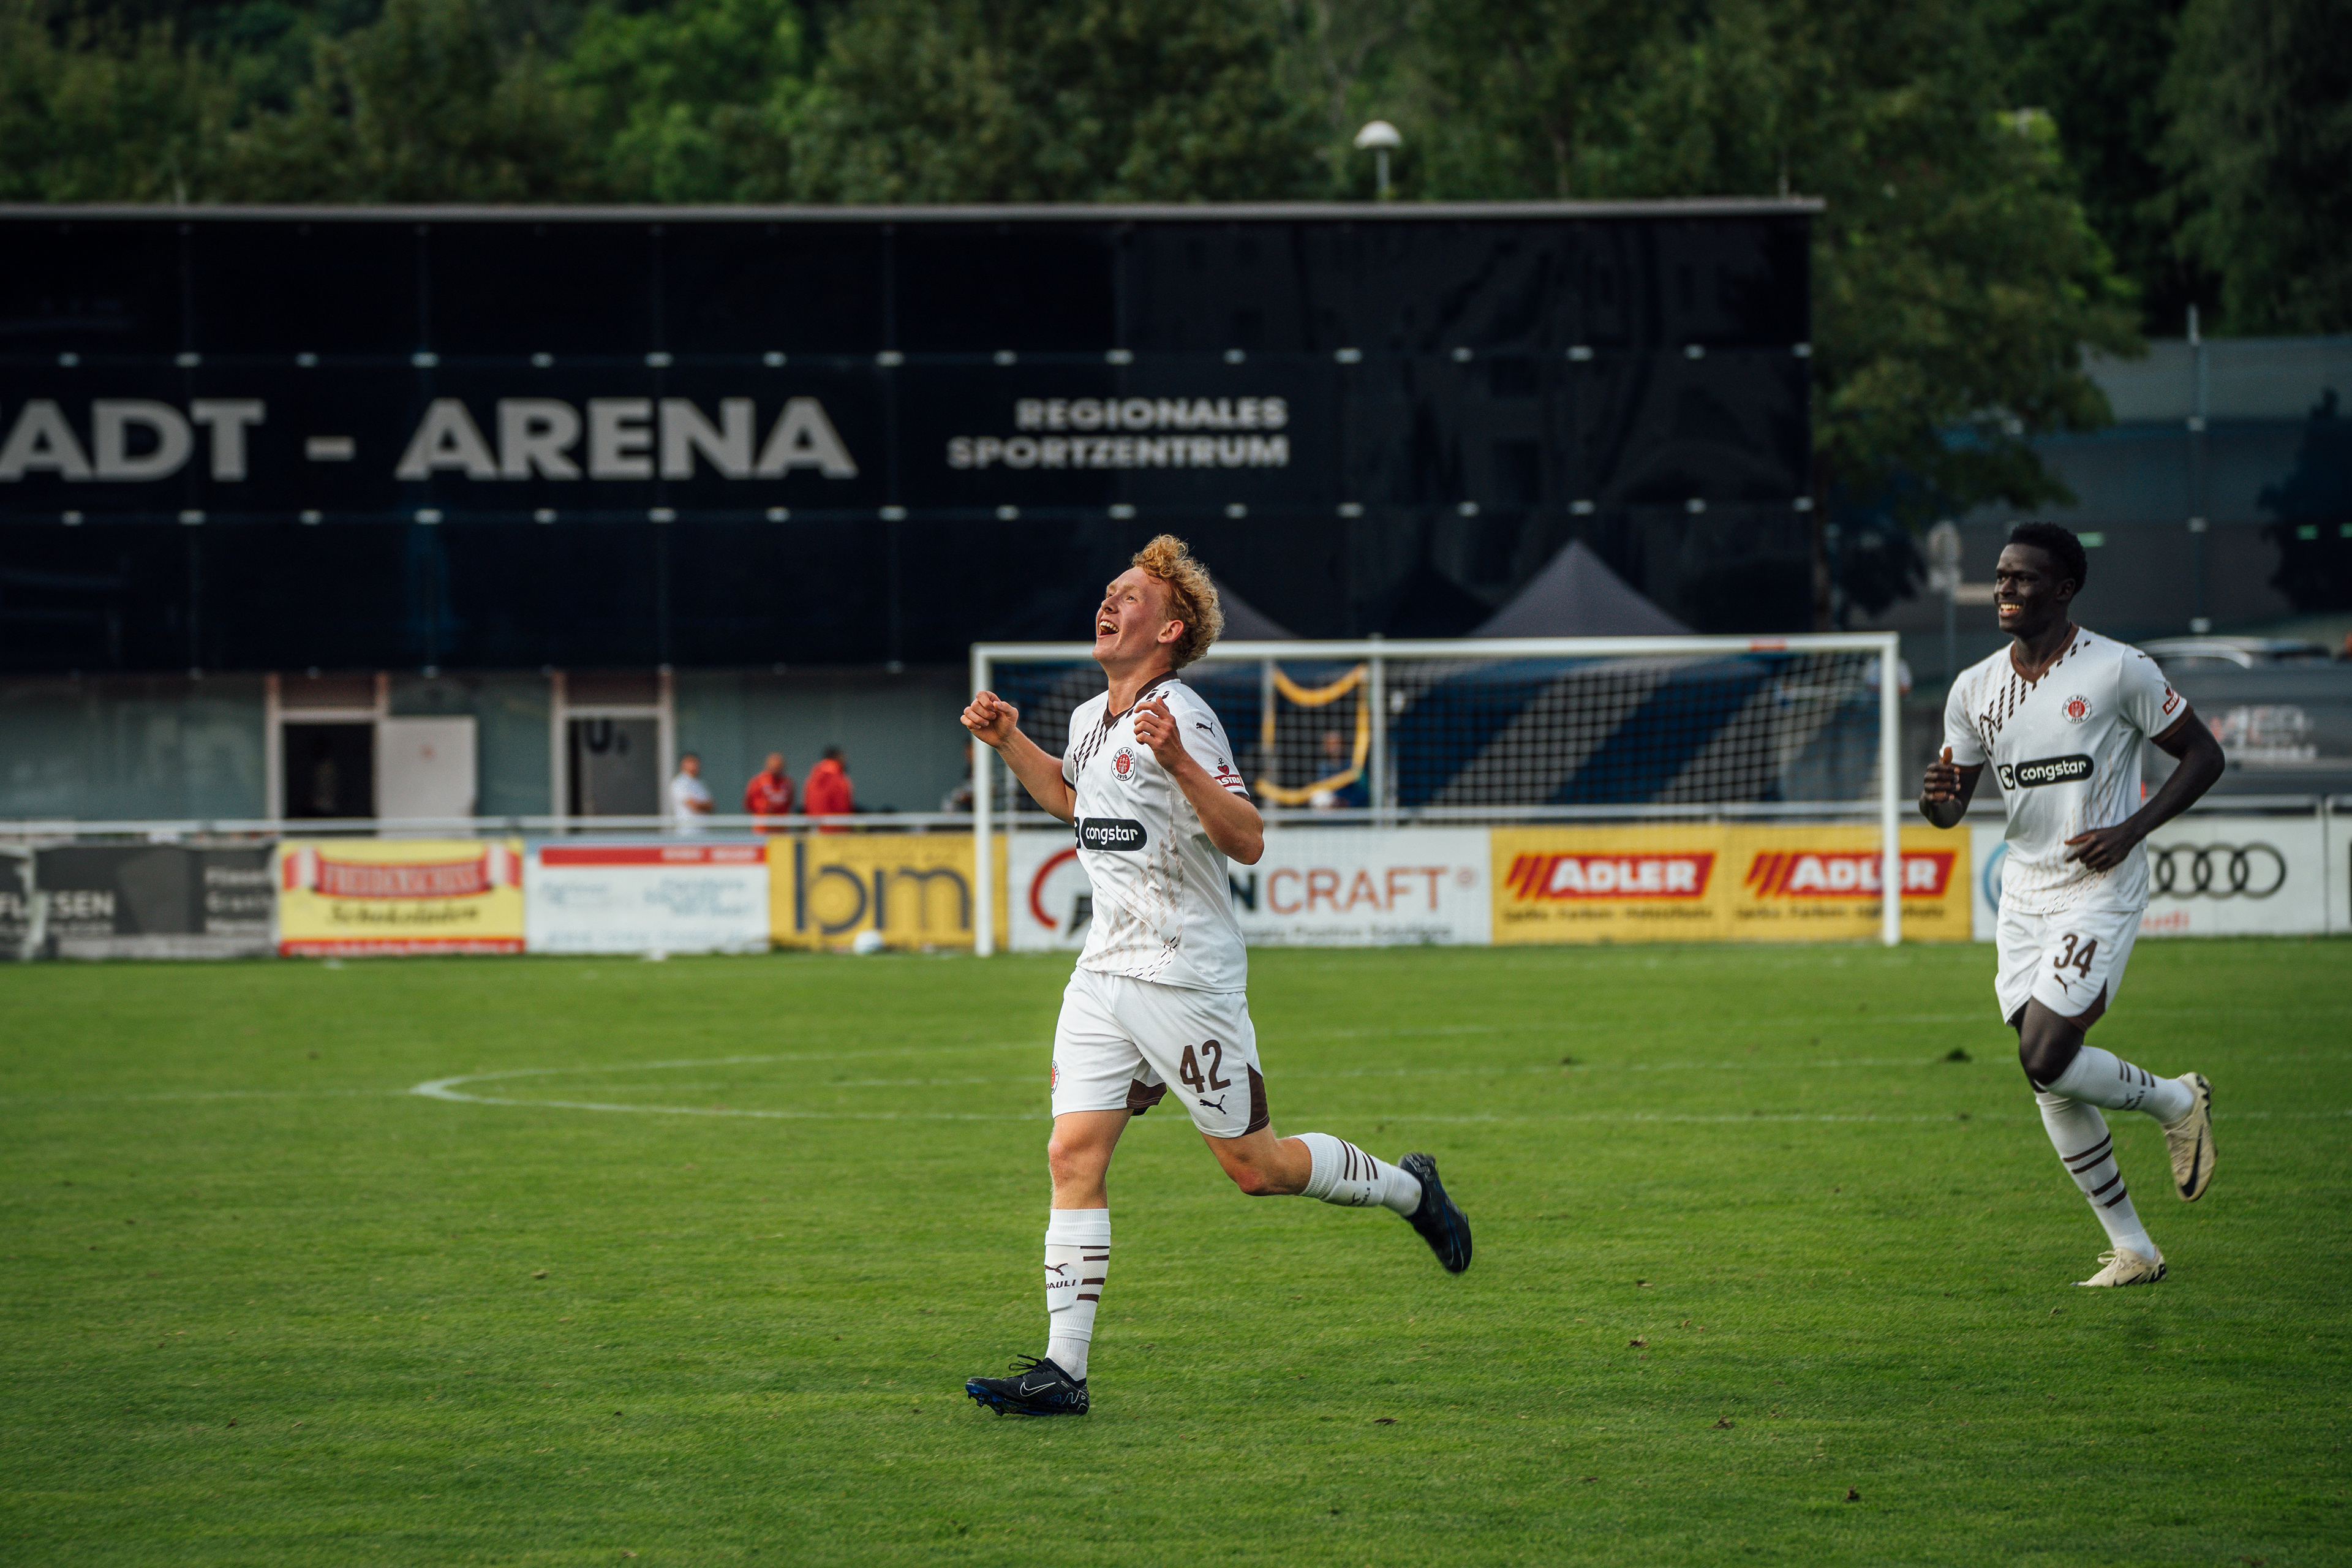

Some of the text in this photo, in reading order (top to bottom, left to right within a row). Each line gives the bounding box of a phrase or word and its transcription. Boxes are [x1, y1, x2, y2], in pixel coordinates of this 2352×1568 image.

[1016, 398, 1286, 429] REGIONALES
[395, 399, 858, 480] ARENA
[946, 435, 1288, 469] SPORTZENTRUM
[1125, 748, 1134, 764] PAULI
[2021, 760, 2086, 781] congstar
[1086, 825, 1138, 845] congstar
[1550, 858, 1698, 892] ADLER
[1790, 856, 1939, 890] ADLR
[2054, 933, 2098, 979] 34
[1180, 1039, 1231, 1093] 42
